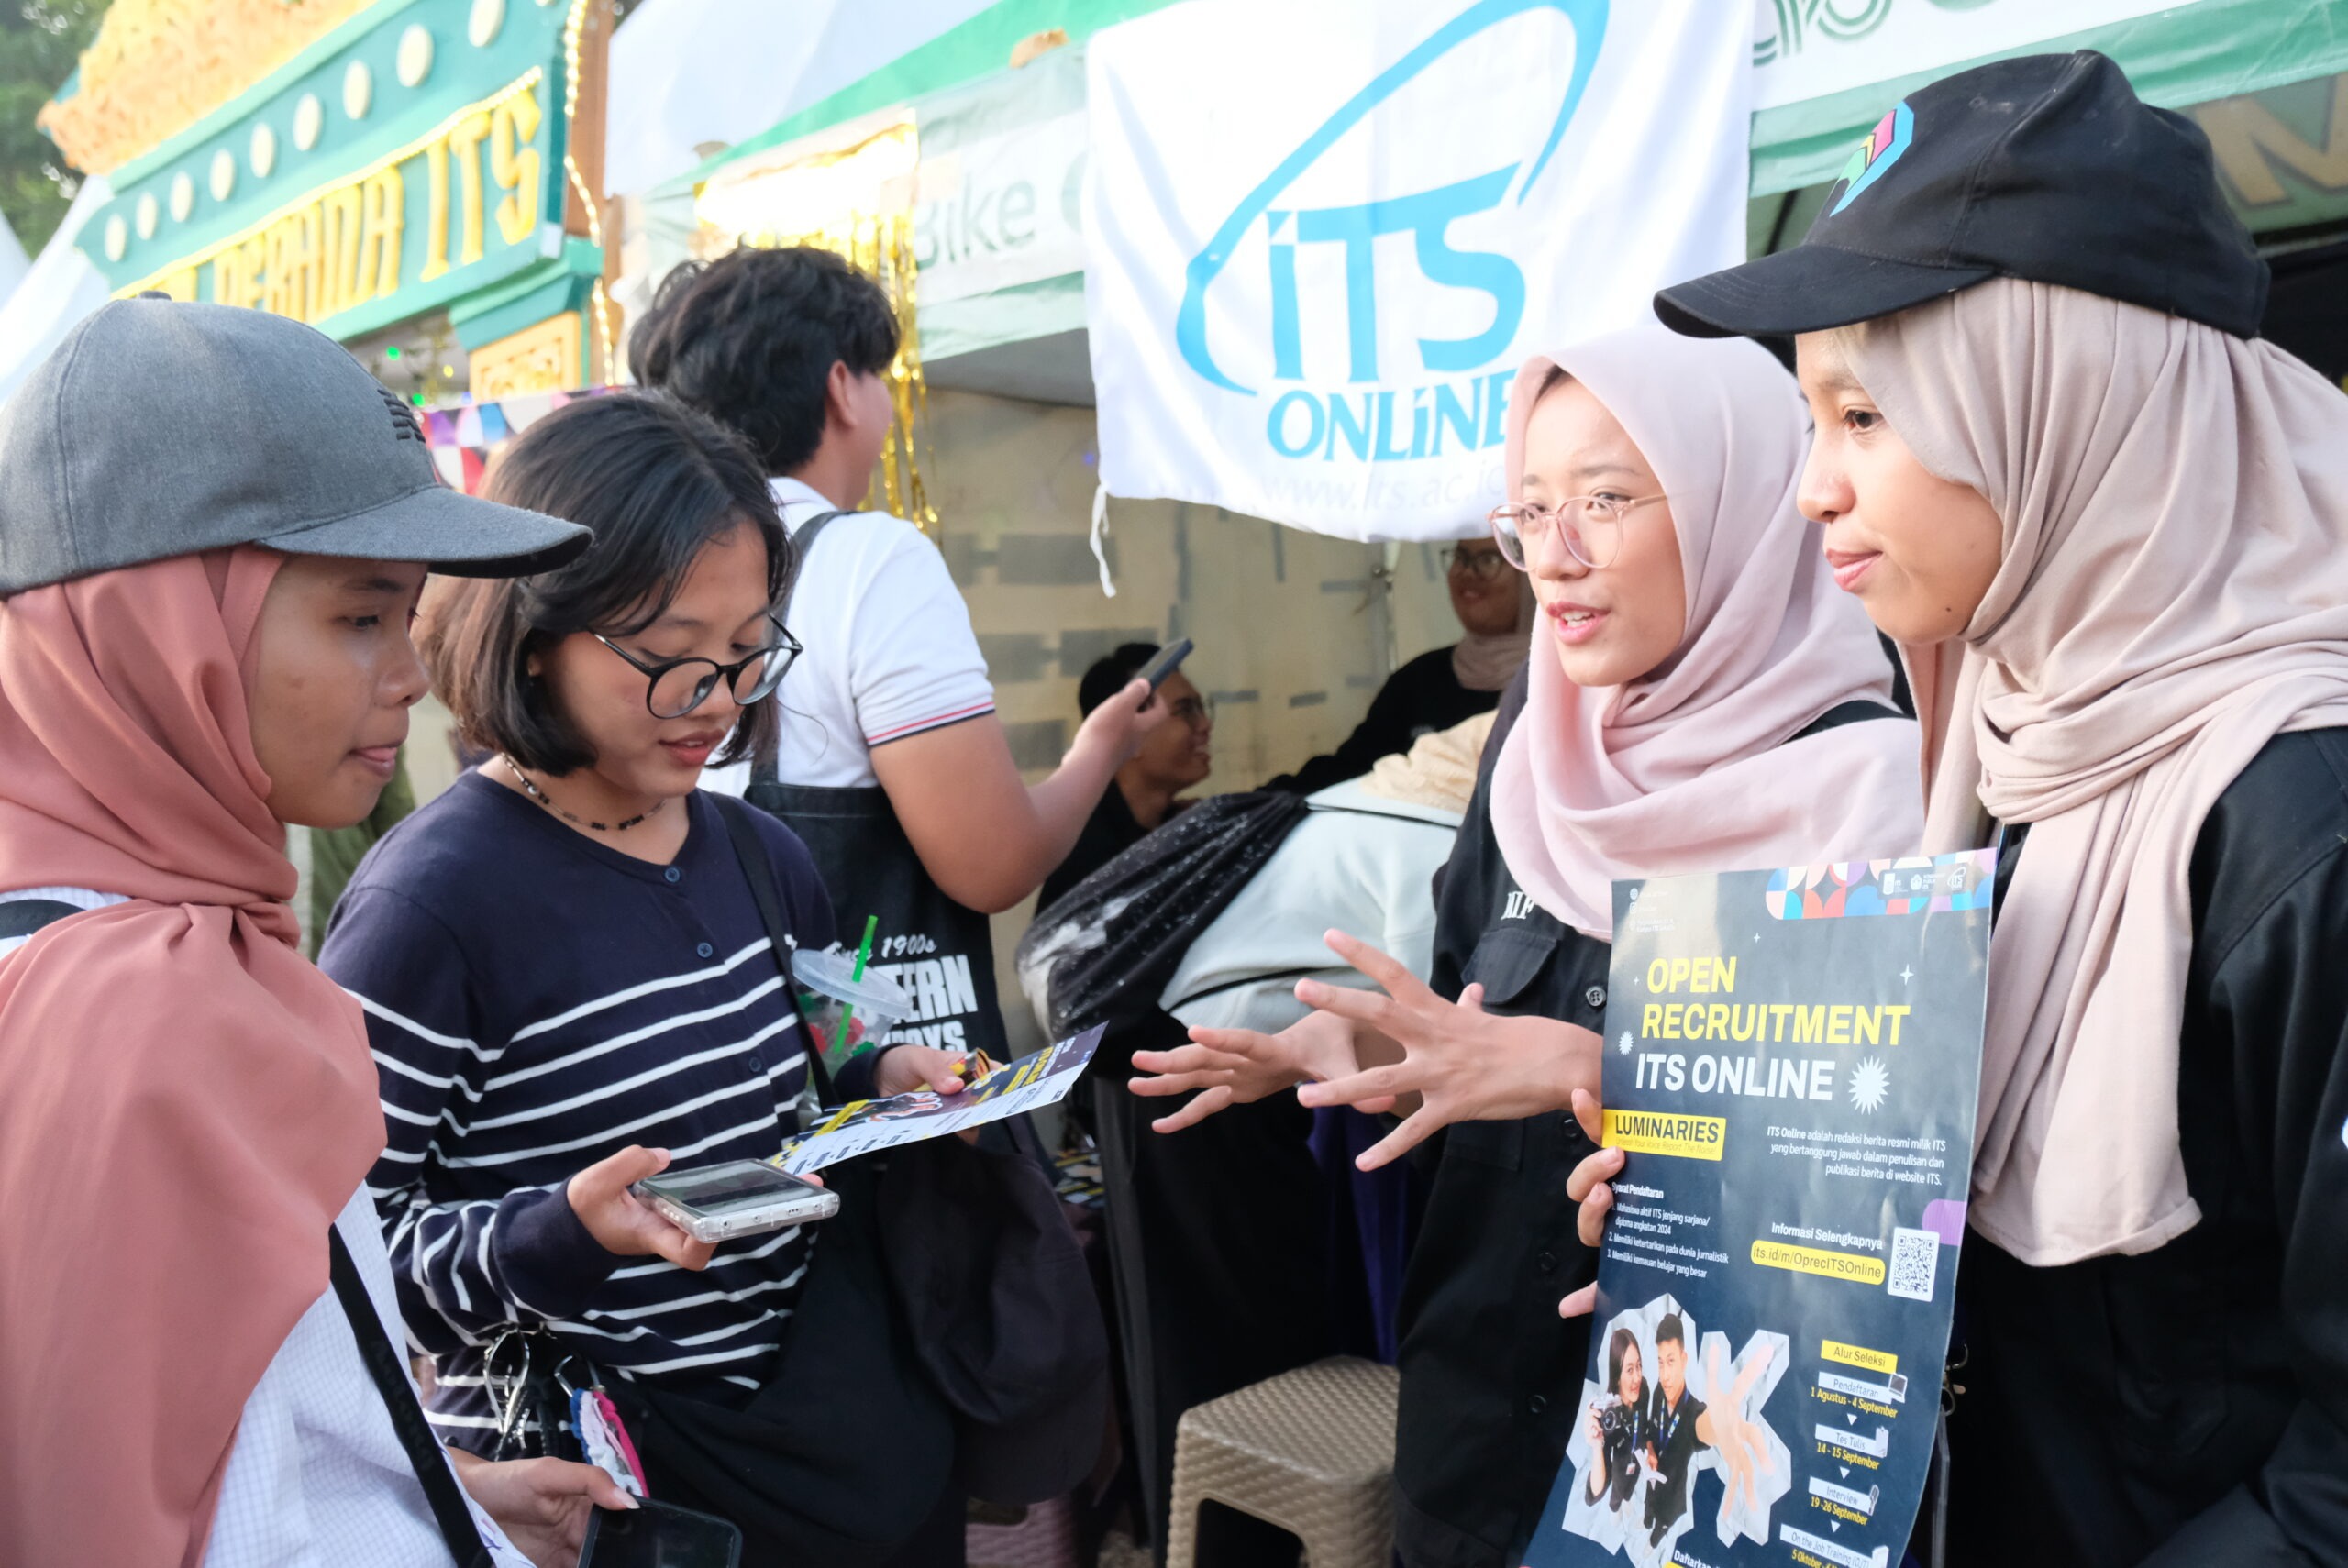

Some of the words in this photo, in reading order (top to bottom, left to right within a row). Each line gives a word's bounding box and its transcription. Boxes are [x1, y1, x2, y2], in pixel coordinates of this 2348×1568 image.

[421, 90, 543, 282] ITS
[881, 933, 937, 958] 1900s
[1647, 956, 1737, 993] OPEN
[1642, 1003, 1911, 1045] RECRUITMENT
[1636, 1053, 1686, 1091] ITS
[1691, 1056, 1835, 1101] ONLINE
[1615, 1115, 1720, 1143] LUMINARIES
[1767, 1126, 1780, 1137] ITS
[1781, 1127, 1806, 1140] Online
[1807, 1130, 1833, 1142] adalah
[1834, 1132, 1862, 1144] redaksi
[1863, 1133, 1887, 1147] berita
[1888, 1137, 1910, 1148] resmi
[1911, 1139, 1931, 1151] milik
[1933, 1139, 1946, 1152] ITS
[1662, 1141, 1682, 1152] Report
[1770, 1143, 1789, 1156] yang
[1789, 1143, 1837, 1161] bertanggung
[1837, 1148, 1862, 1161] jawab
[1863, 1150, 1887, 1163] dalam
[1888, 1154, 1927, 1166] penulisan
[1928, 1155, 1944, 1168] dan
[1825, 1163, 1860, 1176] publikasi
[1861, 1165, 1884, 1179] berita
[1885, 1168, 1893, 1180] di
[1894, 1170, 1925, 1184] website
[1927, 1173, 1942, 1186] ITS.
[1629, 1184, 1664, 1199] Pendaftaran
[1633, 1220, 1656, 1232] angkatan
[1656, 1224, 1671, 1235] 2024
[1640, 1206, 1652, 1218] aktif
[1652, 1208, 1662, 1220] ITS
[1662, 1209, 1684, 1226] jenjang
[1684, 1215, 1711, 1227] sarjana/
[1772, 1222, 1814, 1239] Informasi
[1815, 1229, 1883, 1251] Selengkapnya
[1634, 1237, 1665, 1252] ketertarikan
[1665, 1242, 1678, 1255] pada
[1678, 1245, 1696, 1258] dunia
[1696, 1248, 1729, 1264] jurnalistik
[1753, 1245, 1881, 1278] its.id/m/OprecITSOnline
[1634, 1253, 1656, 1267] kemauan
[1657, 1259, 1676, 1273] belajar
[1676, 1264, 1689, 1277] yang
[1689, 1265, 1707, 1278] besar
[1833, 1346, 1852, 1359] Alur
[1854, 1351, 1886, 1367] Seleksi
[1833, 1378, 1878, 1398] Pendaftaran
[1811, 1386, 1815, 1397] 1
[1817, 1388, 1847, 1405] Agustus
[1852, 1397, 1857, 1408] 4
[1858, 1398, 1898, 1419] September
[1836, 1432, 1848, 1444] Tes
[1850, 1436, 1866, 1450] Tulis
[1817, 1442, 1826, 1454] 14
[1833, 1446, 1842, 1458] 15
[1842, 1449, 1879, 1470] September
[1826, 1486, 1858, 1506] Interview
[1811, 1496, 1820, 1508] 19
[1833, 1504, 1868, 1526] September
[1791, 1531, 1800, 1542] On
[1802, 1537, 1812, 1548] the
[1813, 1542, 1825, 1553] Job
[1826, 1545, 1852, 1565] Training
[1791, 1549, 1798, 1560] 5
[1798, 1551, 1822, 1568] Oktober
